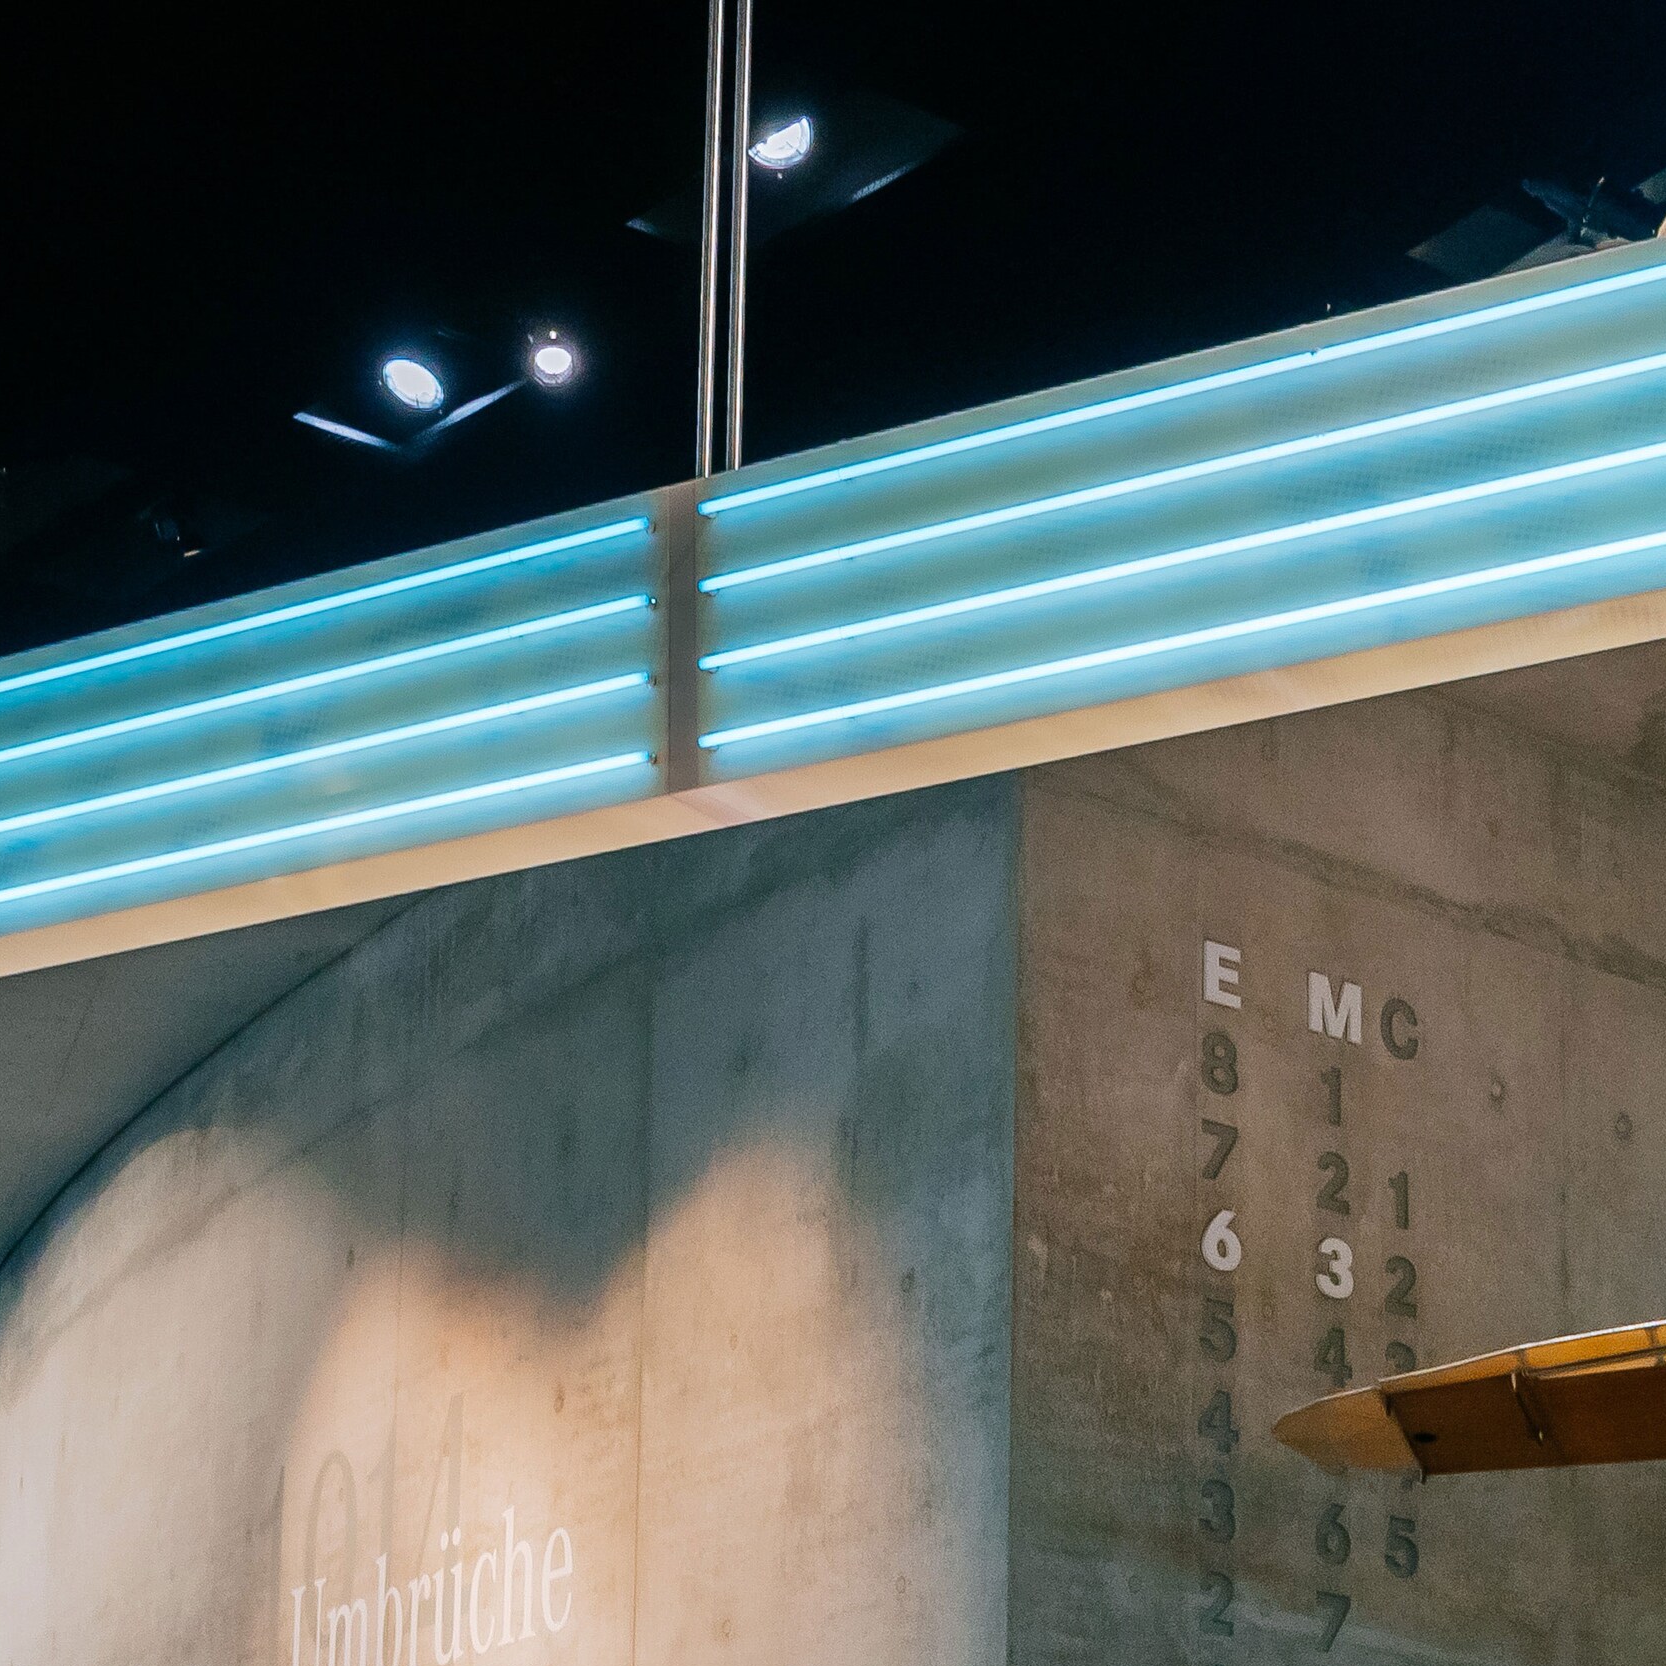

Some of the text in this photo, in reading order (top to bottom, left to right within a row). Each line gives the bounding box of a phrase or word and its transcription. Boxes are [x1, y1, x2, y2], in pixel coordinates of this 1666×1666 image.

[1201, 939, 1419, 1060] E M C
[1200, 1031, 1341, 1127] 8 1
[1201, 1117, 1410, 1230] 7 2 1
[1201, 1208, 1418, 1320] 6 3 2
[1199, 1297, 1237, 1364] 5
[1314, 1325, 1353, 1389] 4
[1197, 1390, 1240, 1454] 4
[1197, 1479, 1419, 1580] 3 6 5
[1198, 1570, 1352, 1653] 2 7
